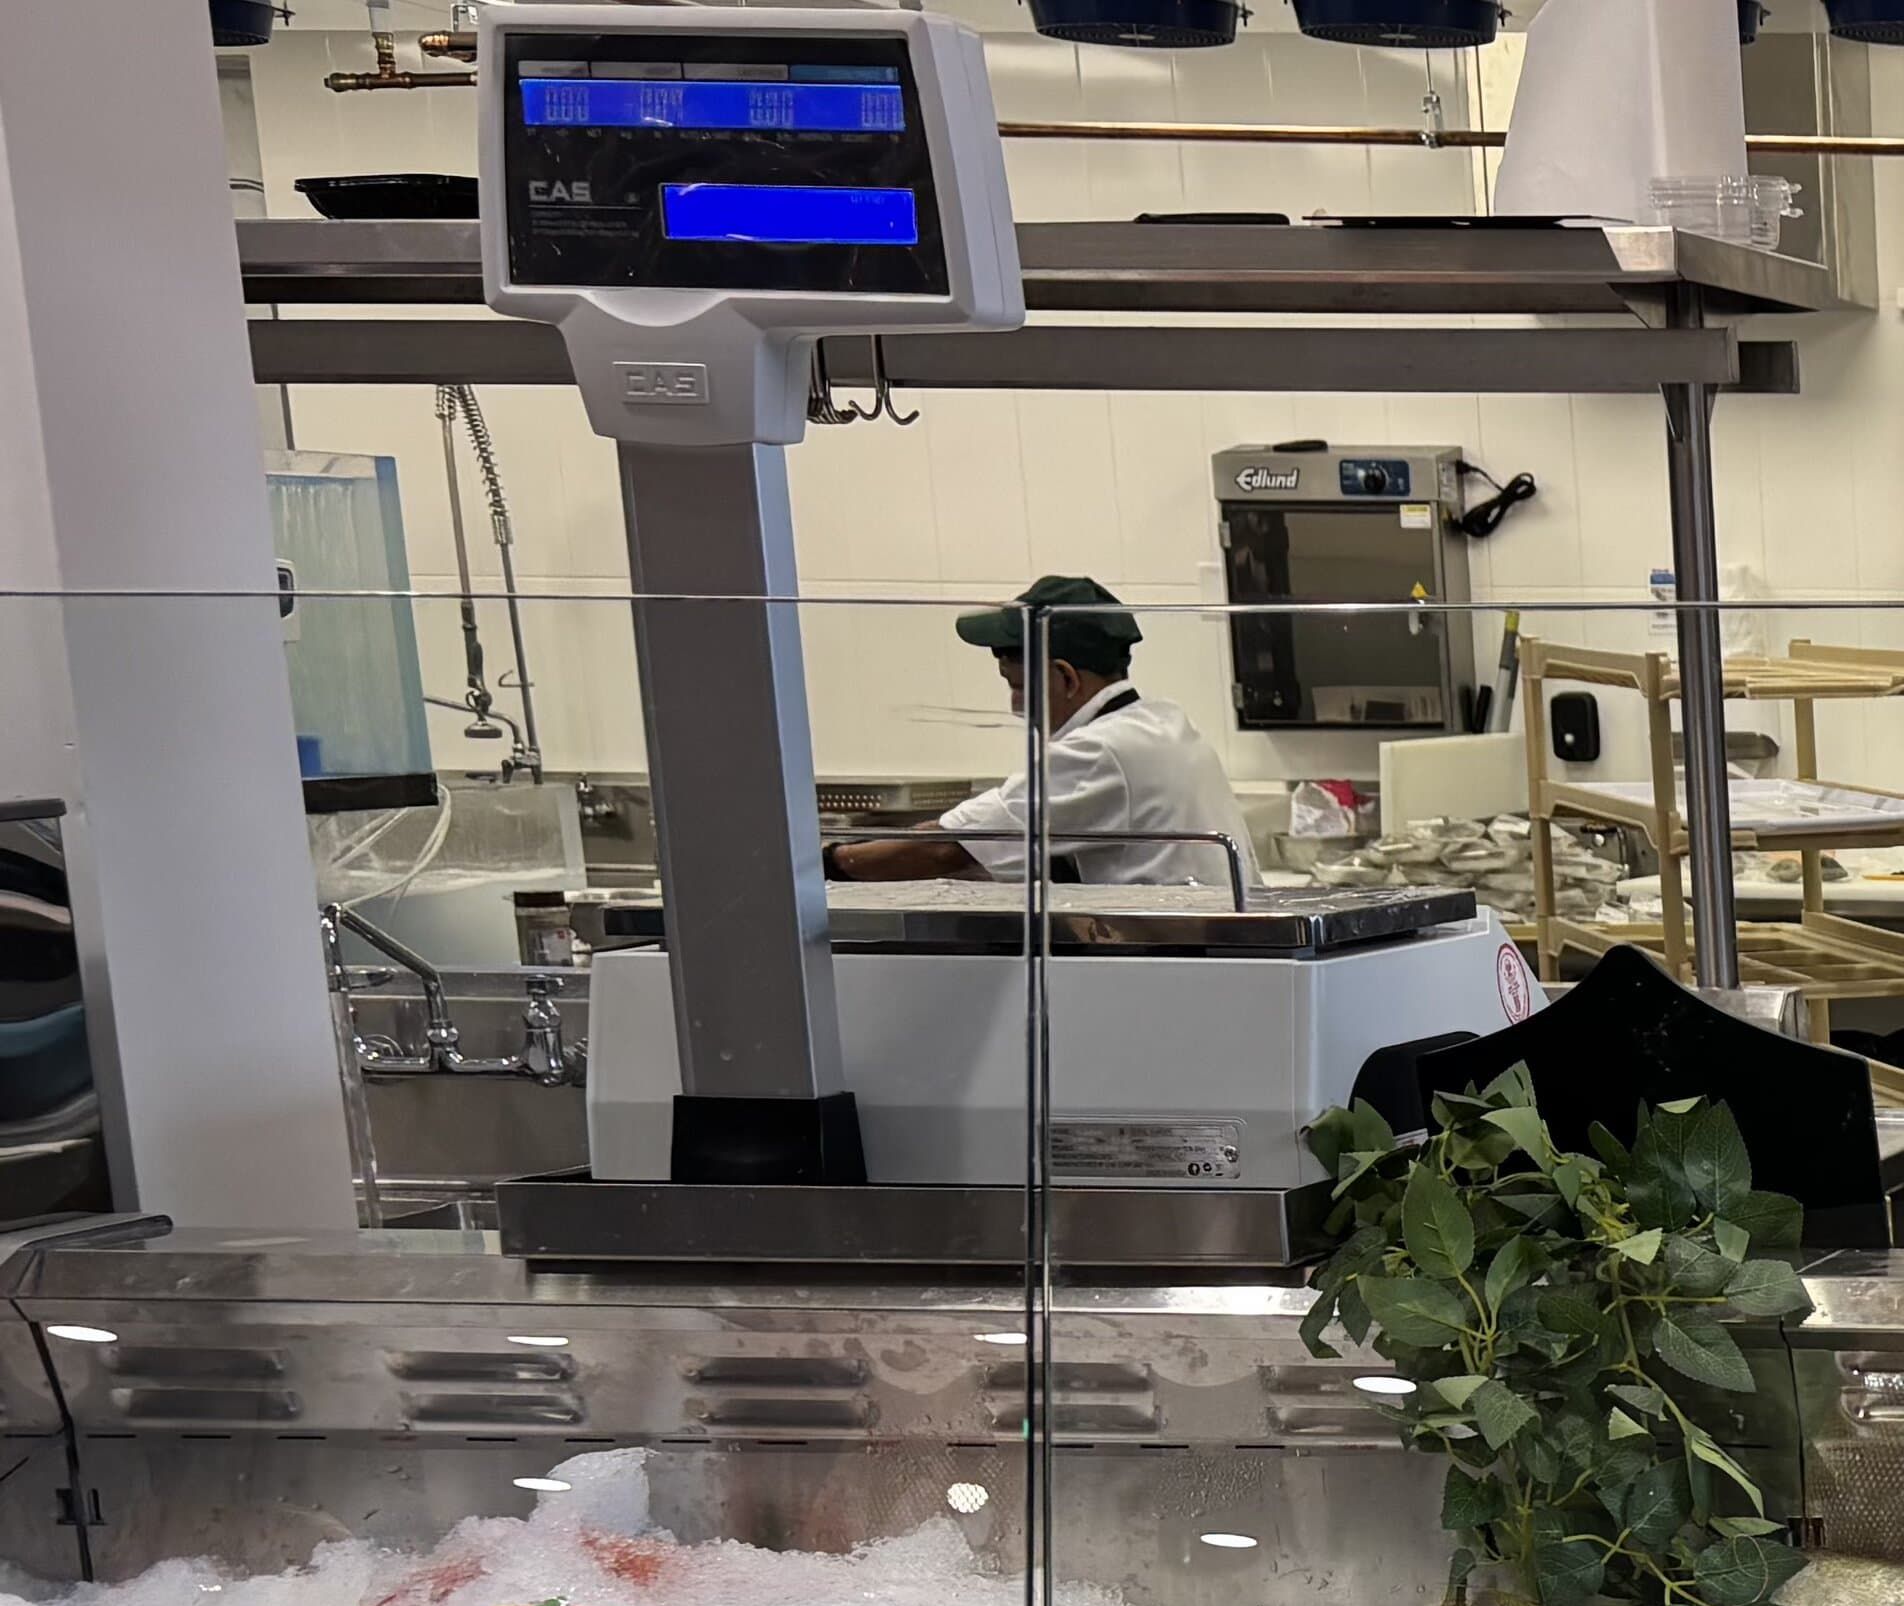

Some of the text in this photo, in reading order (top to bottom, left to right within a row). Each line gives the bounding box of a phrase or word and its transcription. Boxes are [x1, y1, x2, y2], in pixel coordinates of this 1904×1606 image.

[528, 181, 593, 202] CAS
[625, 372, 699, 398] CAS
[1236, 467, 1299, 492] Edlund
